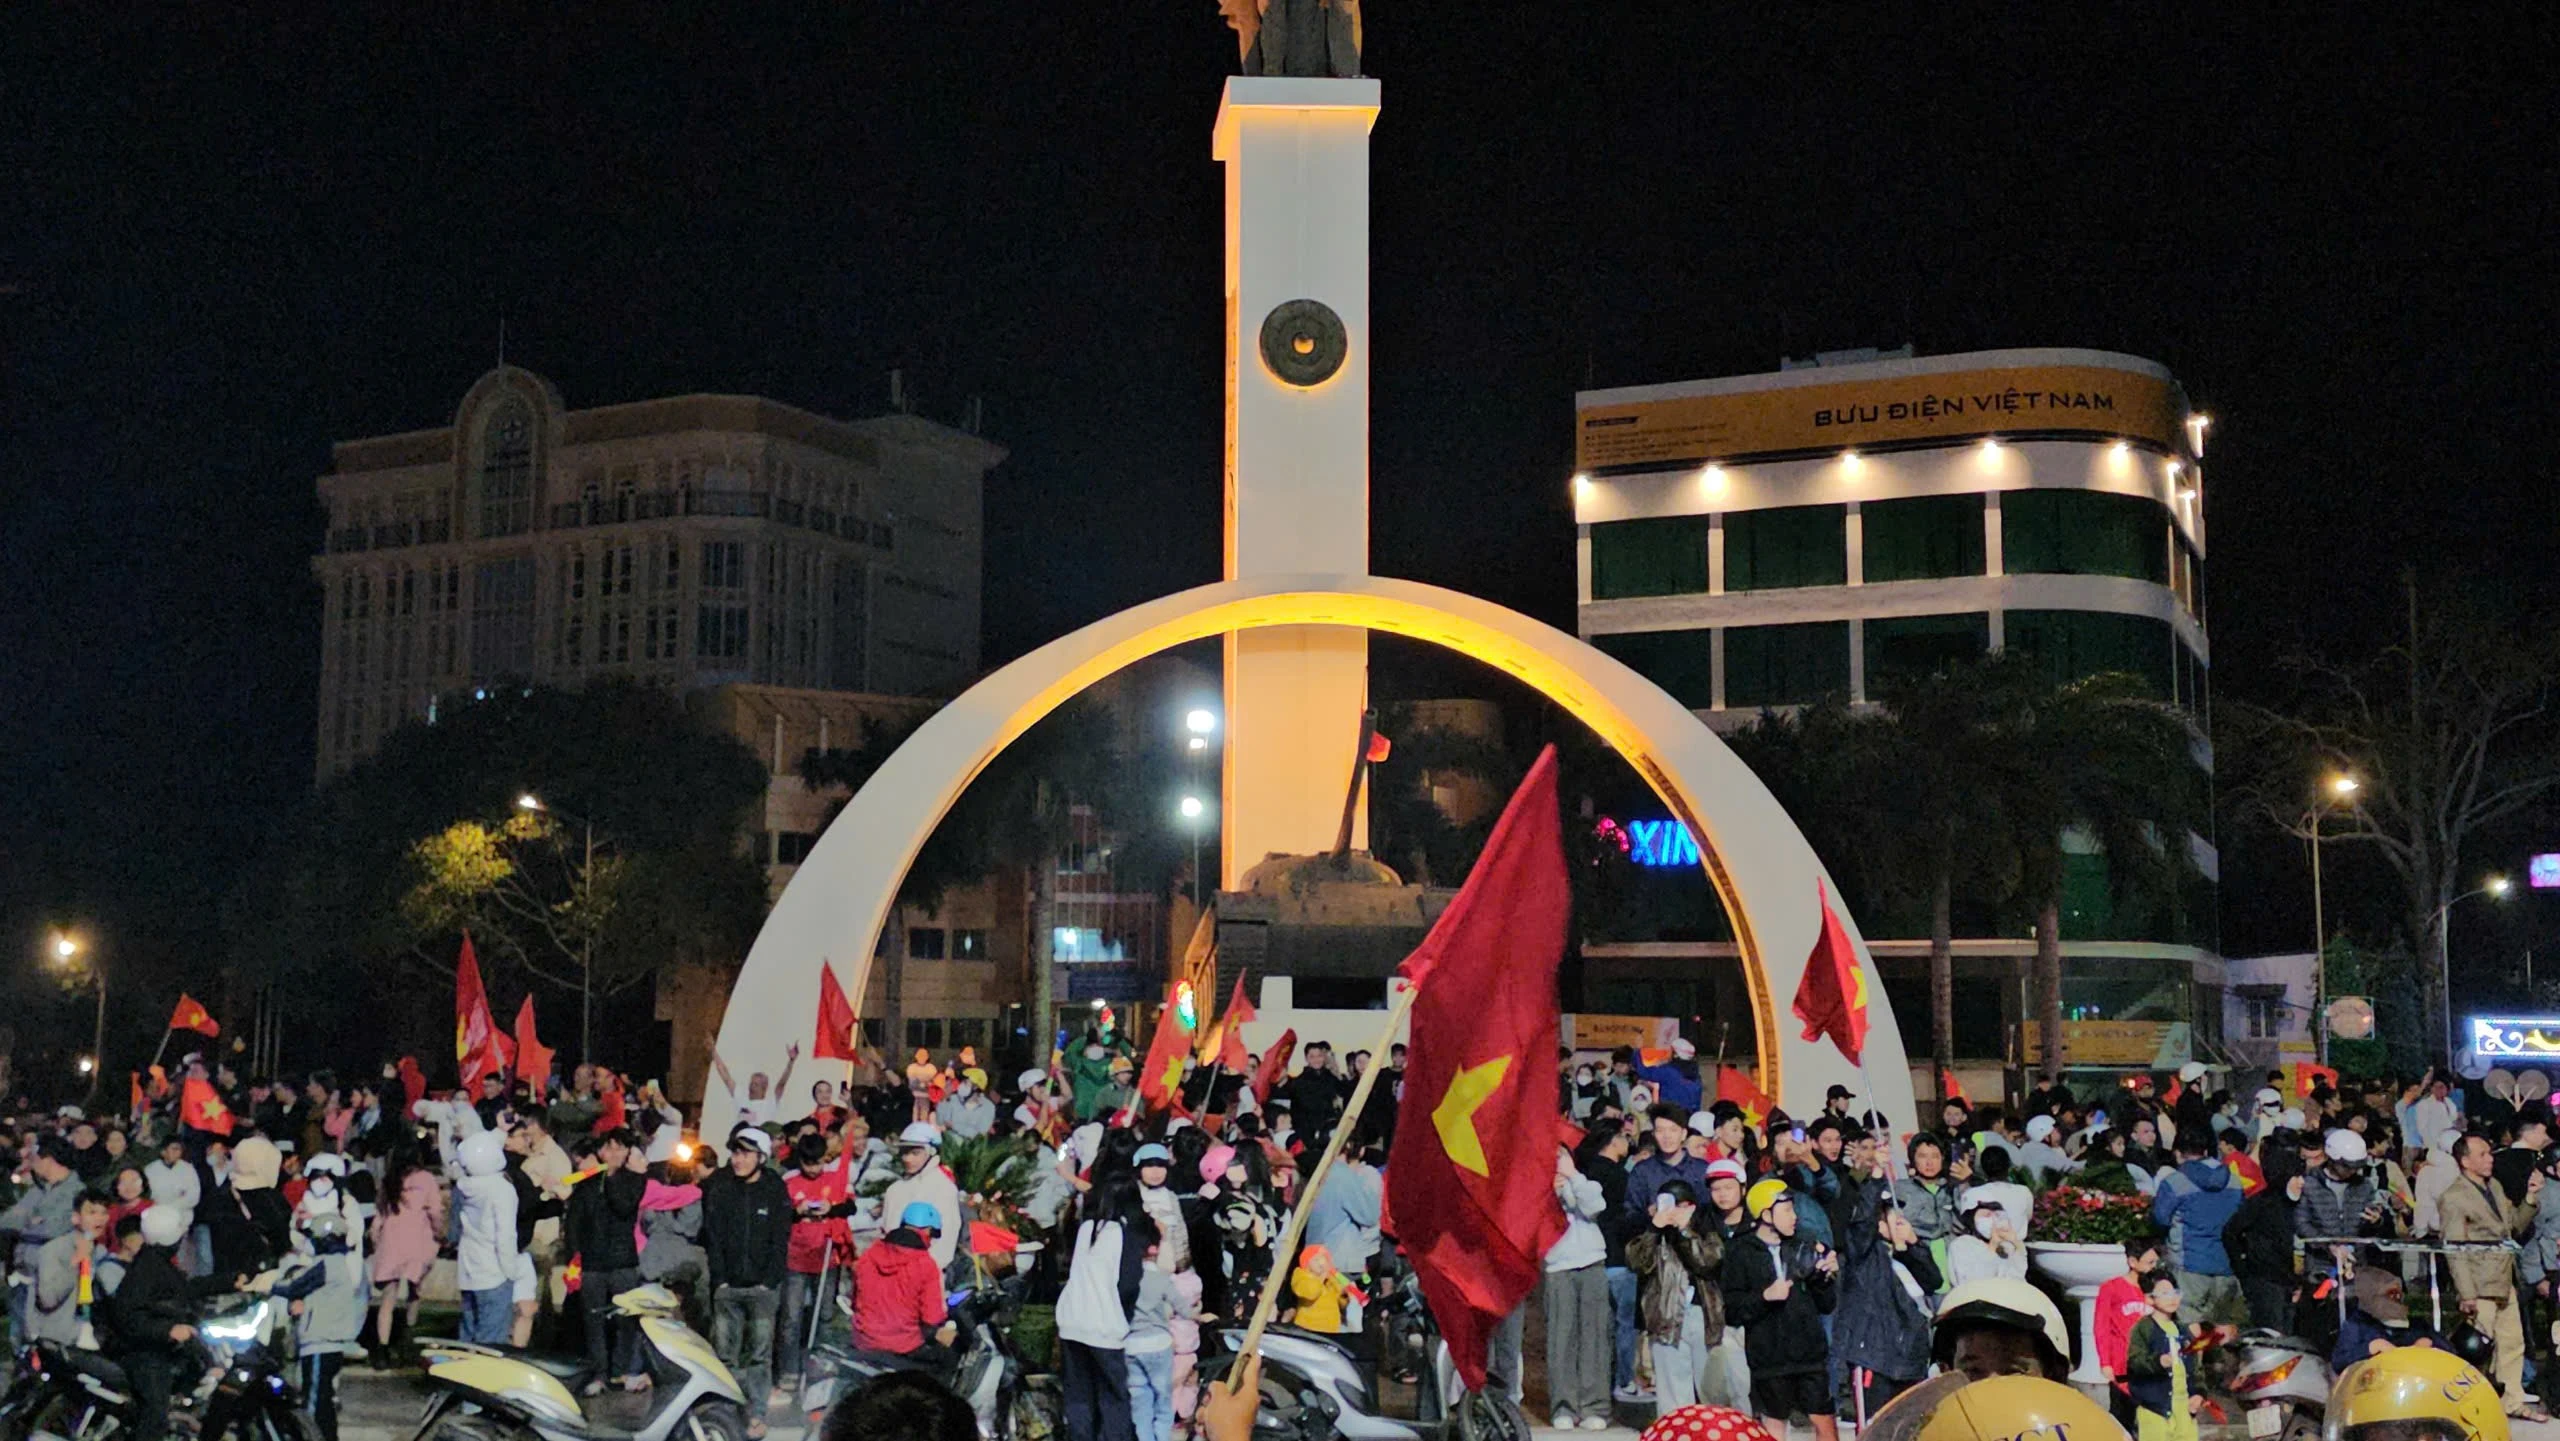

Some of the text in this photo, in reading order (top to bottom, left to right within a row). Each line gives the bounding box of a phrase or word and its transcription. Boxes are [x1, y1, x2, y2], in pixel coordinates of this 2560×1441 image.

[1814, 387, 2114, 427] BƯU ĐIỆN VIỆT NAM
